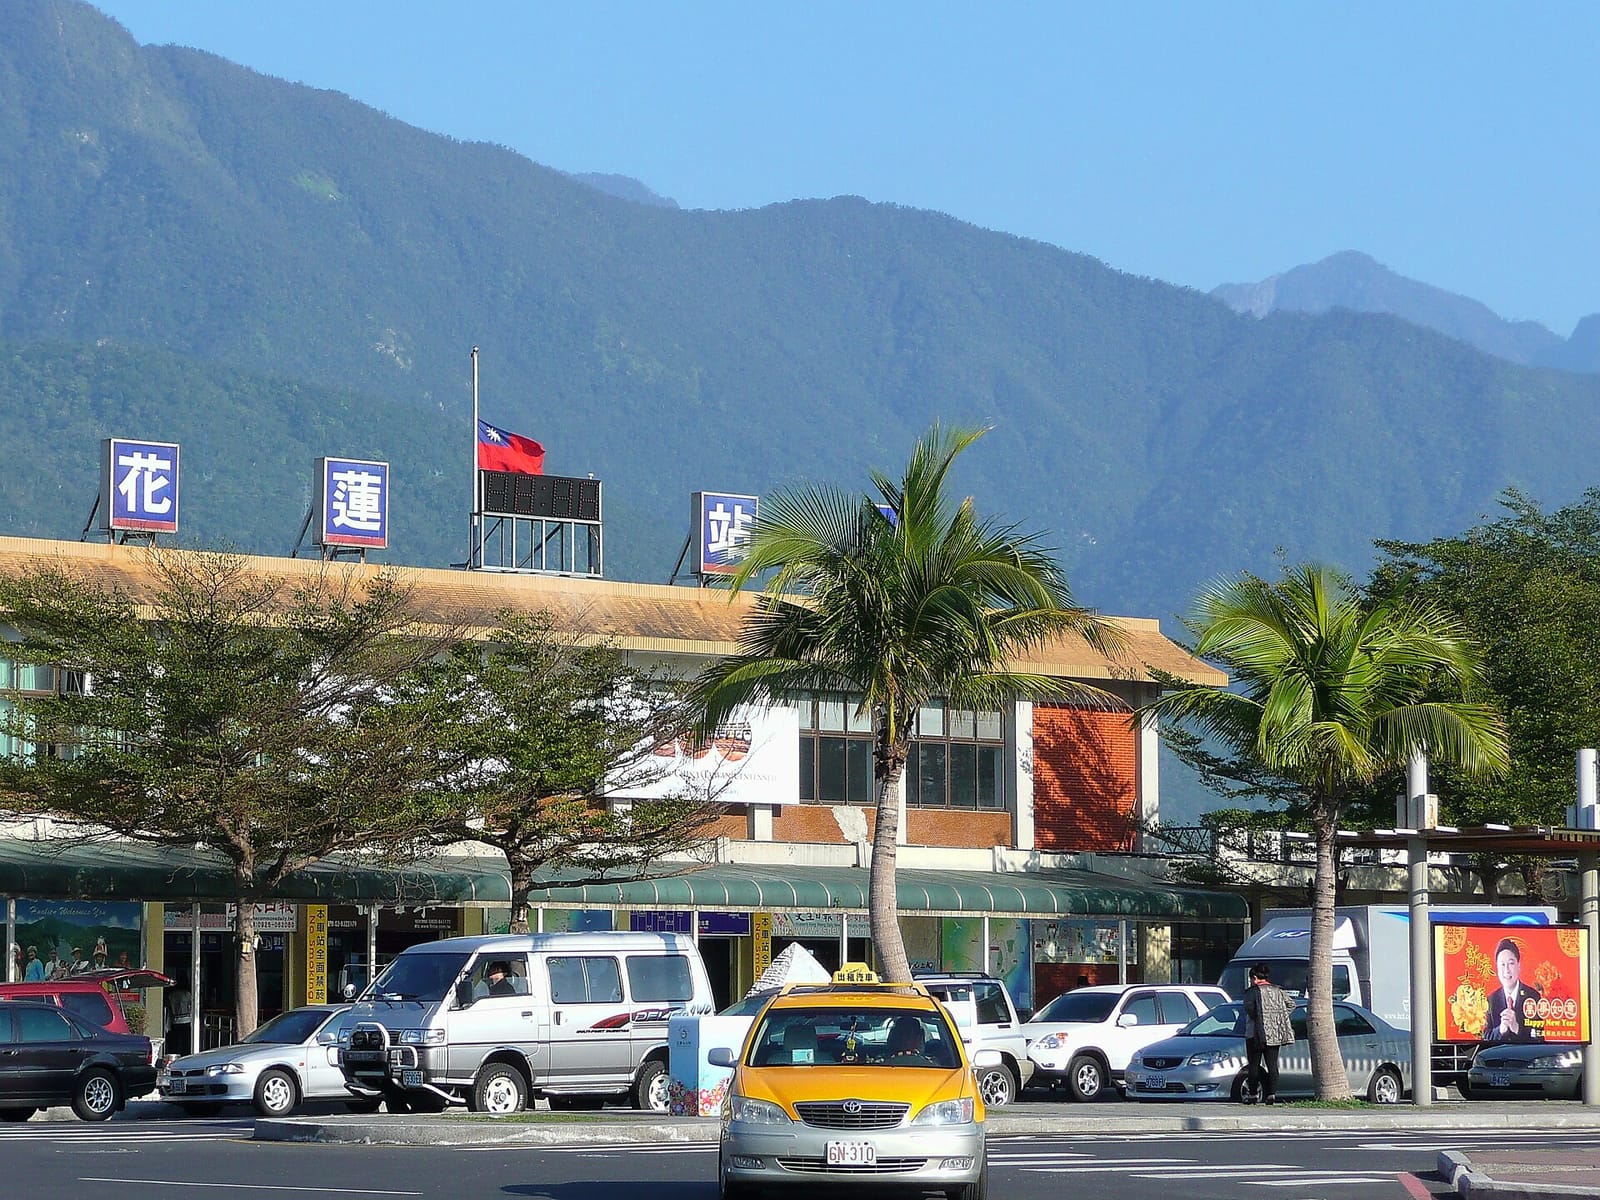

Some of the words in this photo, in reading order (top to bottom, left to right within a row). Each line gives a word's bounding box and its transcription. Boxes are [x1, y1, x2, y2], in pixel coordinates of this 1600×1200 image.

[117, 452, 172, 513] 花
[331, 470, 382, 531] 蓮
[708, 502, 753, 560] 站
[1524, 1018, 1545, 1028] Happy
[1546, 1018, 1560, 1027] New
[1562, 1018, 1577, 1027] Year
